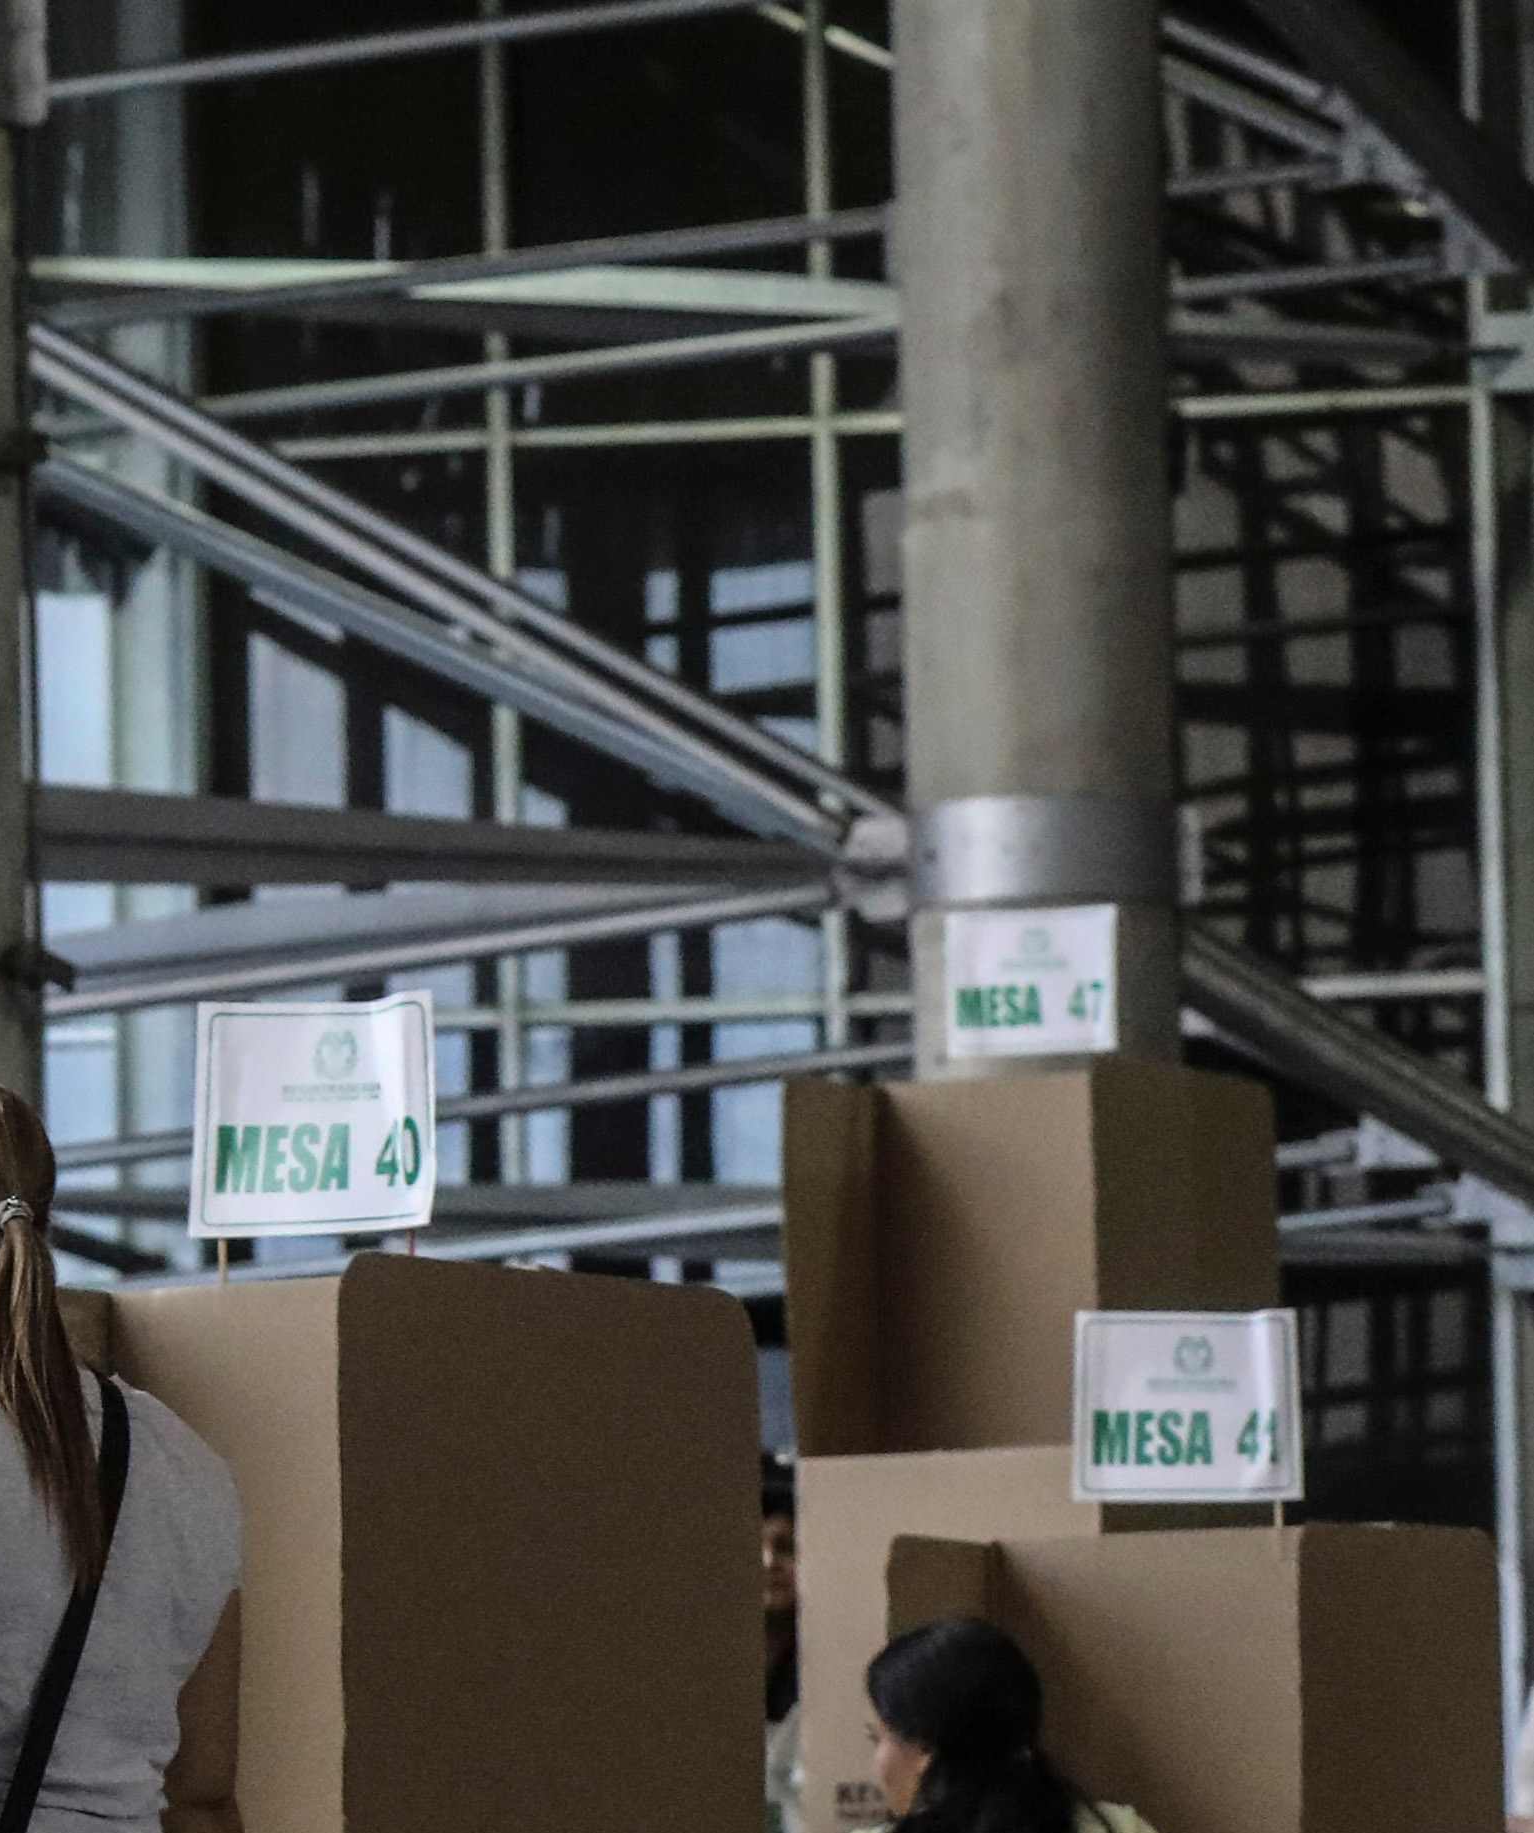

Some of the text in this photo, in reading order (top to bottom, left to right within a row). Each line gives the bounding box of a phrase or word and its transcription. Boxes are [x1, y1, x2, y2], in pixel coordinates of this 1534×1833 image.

[954, 984, 1042, 1029] MESA
[214, 1115, 422, 1194] MESA 40
[1092, 1409, 1214, 1466] MESA
